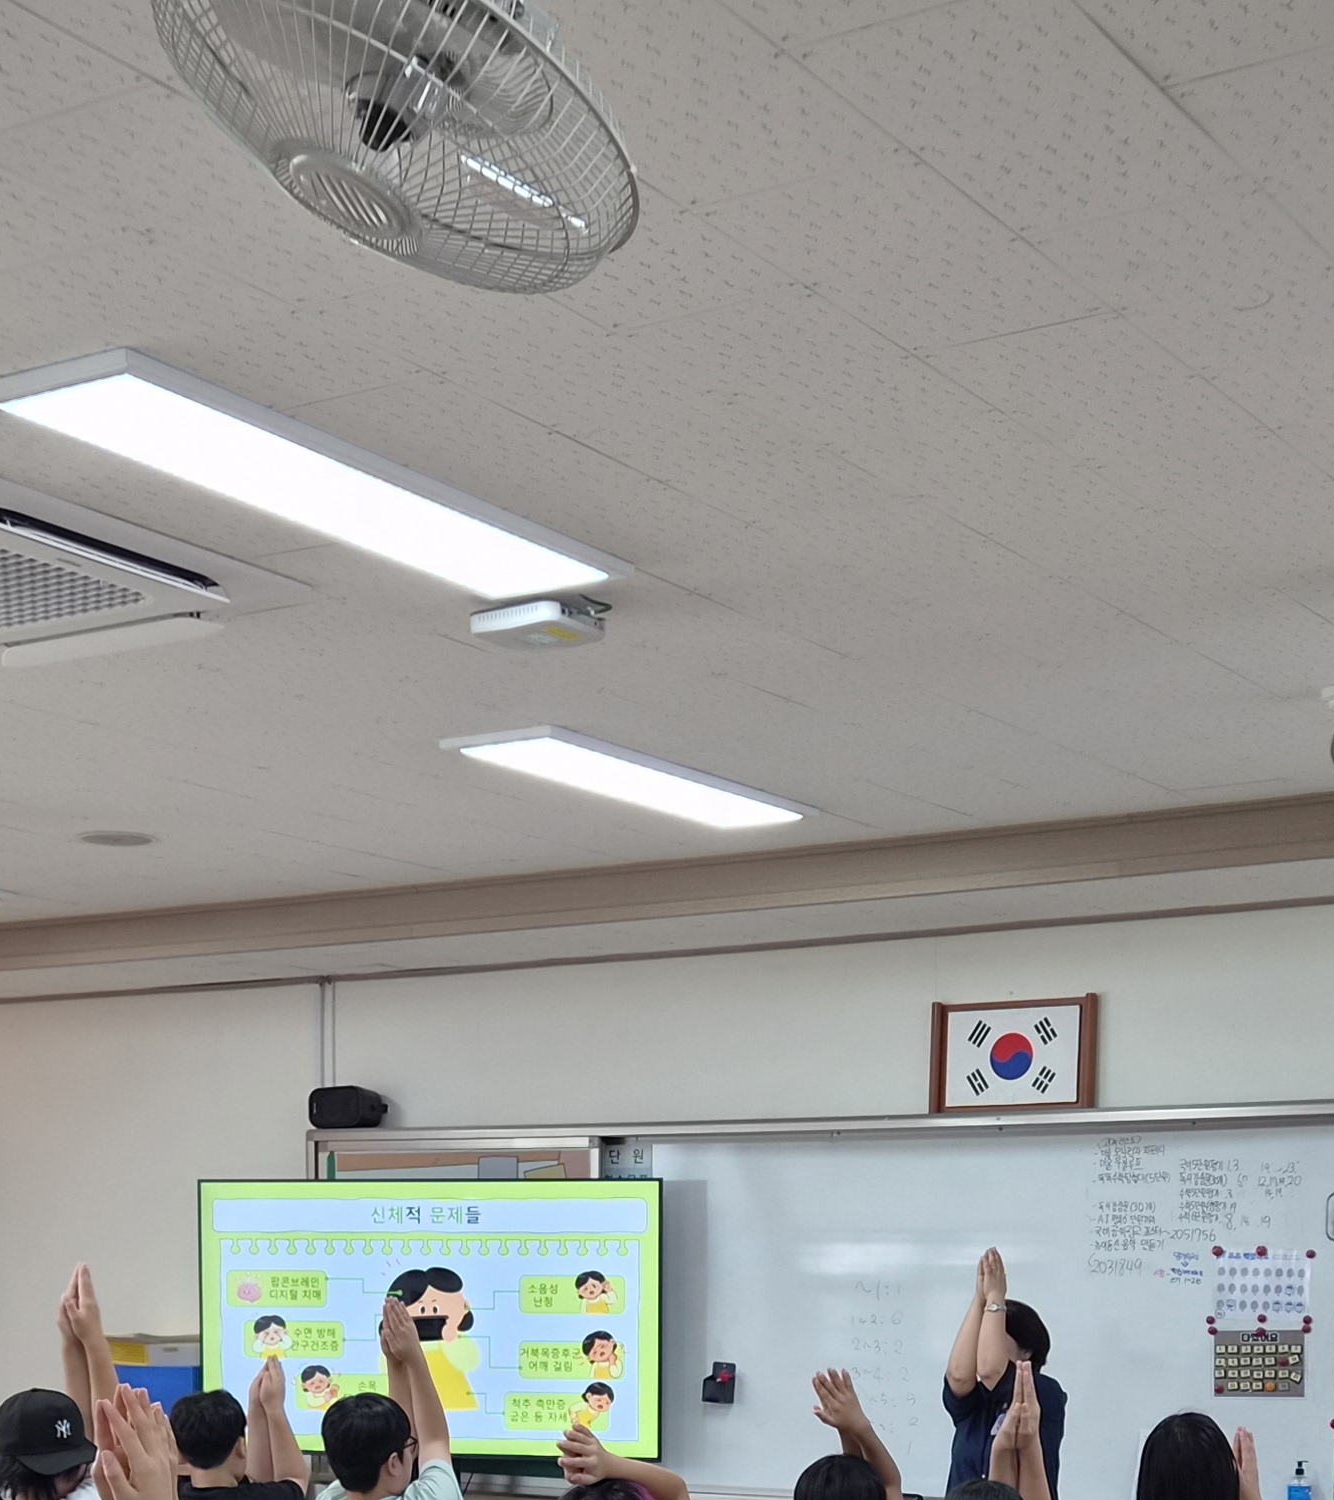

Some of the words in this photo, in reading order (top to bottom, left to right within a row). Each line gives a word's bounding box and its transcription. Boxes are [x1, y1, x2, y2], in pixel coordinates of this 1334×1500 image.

[371, 1206, 420, 1224] 신체적
[430, 1206, 481, 1224] 문제들
[1170, 1227, 1217, 1242] 2051756
[271, 1276, 319, 1288] 팝콘브레인
[269, 1289, 298, 1300] 디지털
[302, 1289, 321, 1300] 치매
[528, 1283, 558, 1295] 소음성
[533, 1297, 553, 1308] 난청
[294, 1328, 312, 1338] 수면
[316, 1328, 336, 1338] 방해
[292, 1340, 339, 1352] 안구건조증
[520, 1348, 580, 1359] 거북목증후군
[529, 1361, 548, 1372] 어깨
[358, 1380, 377, 1391] 손목
[512, 1399, 531, 1409] 척추
[536, 1399, 566, 1410] 측만증
[510, 1412, 529, 1422] 굽은
[534, 1412, 543, 1422] 등
[548, 1412, 567, 1421] 자세
